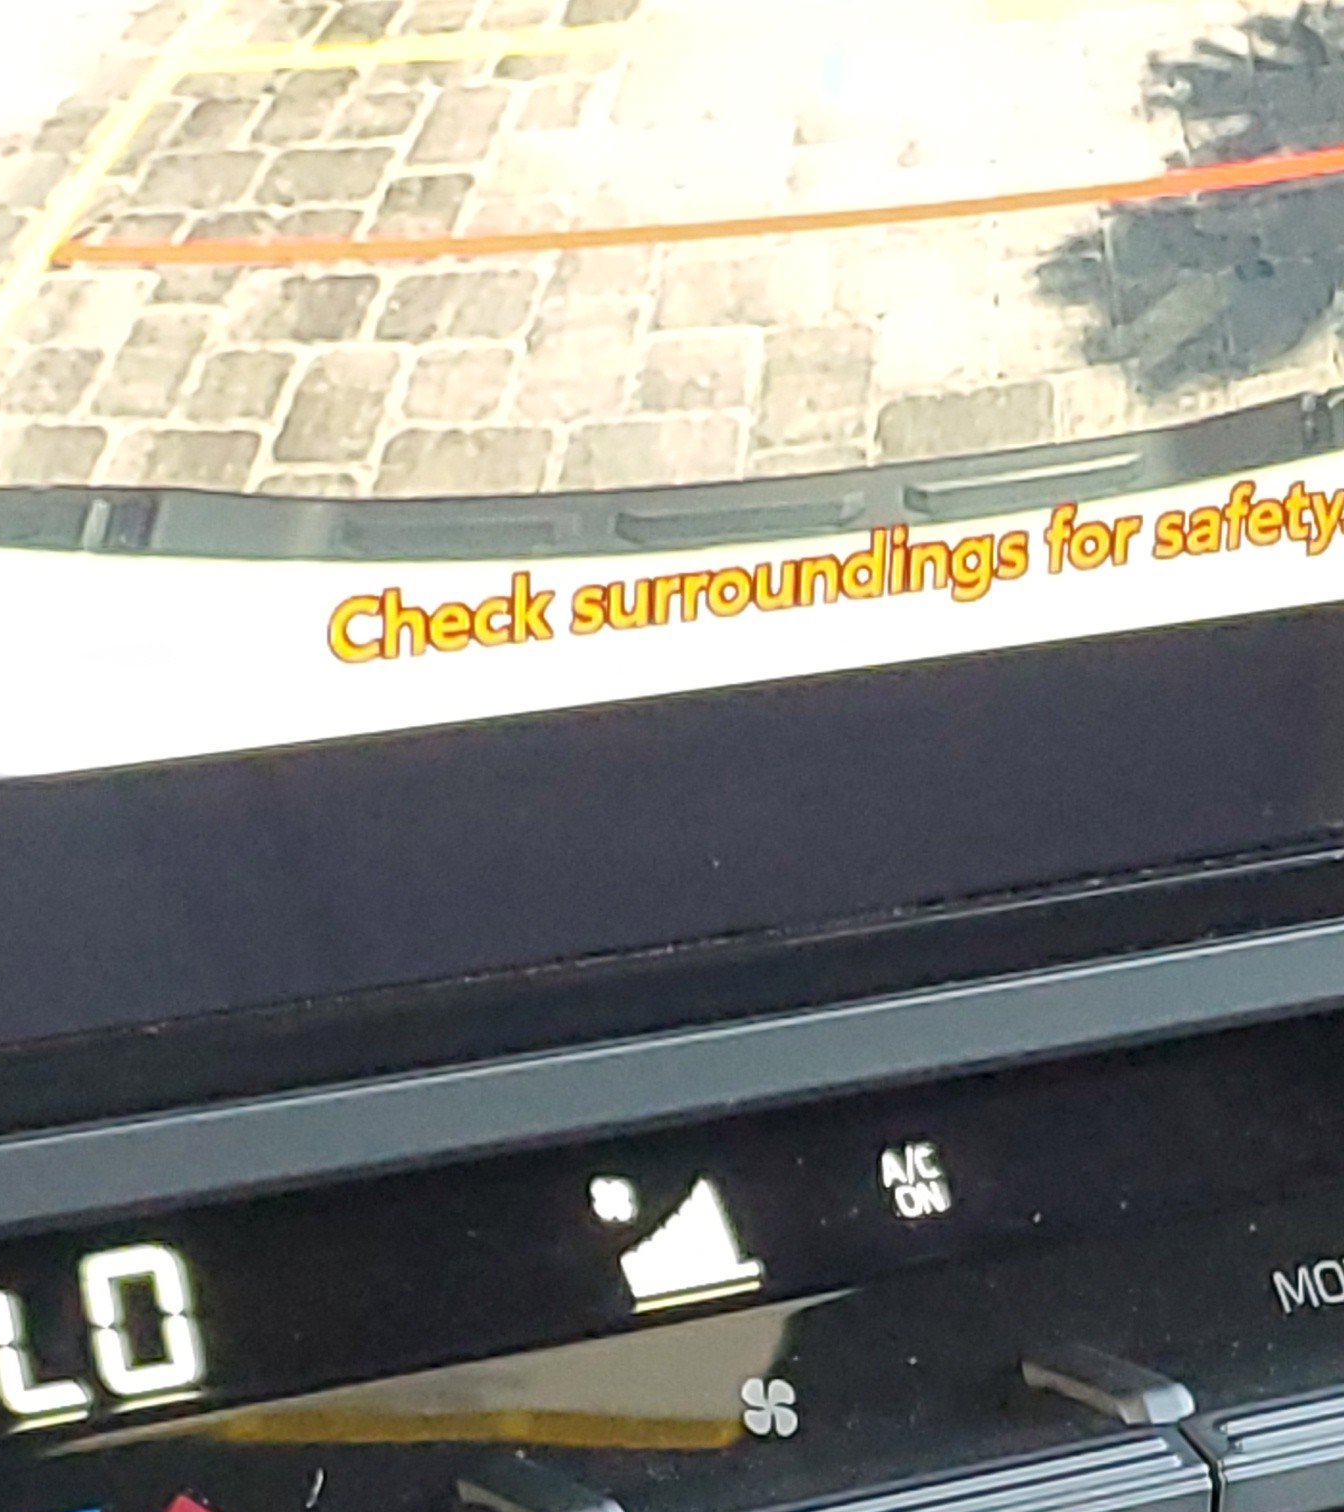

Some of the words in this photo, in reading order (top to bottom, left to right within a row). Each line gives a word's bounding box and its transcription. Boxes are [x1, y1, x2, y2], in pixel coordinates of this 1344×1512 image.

[329, 571, 553, 663] Check
[570, 524, 1029, 636] surroundings
[1044, 502, 1143, 574] for
[881, 1142, 942, 1189] A/C
[893, 1181, 951, 1219] ON
